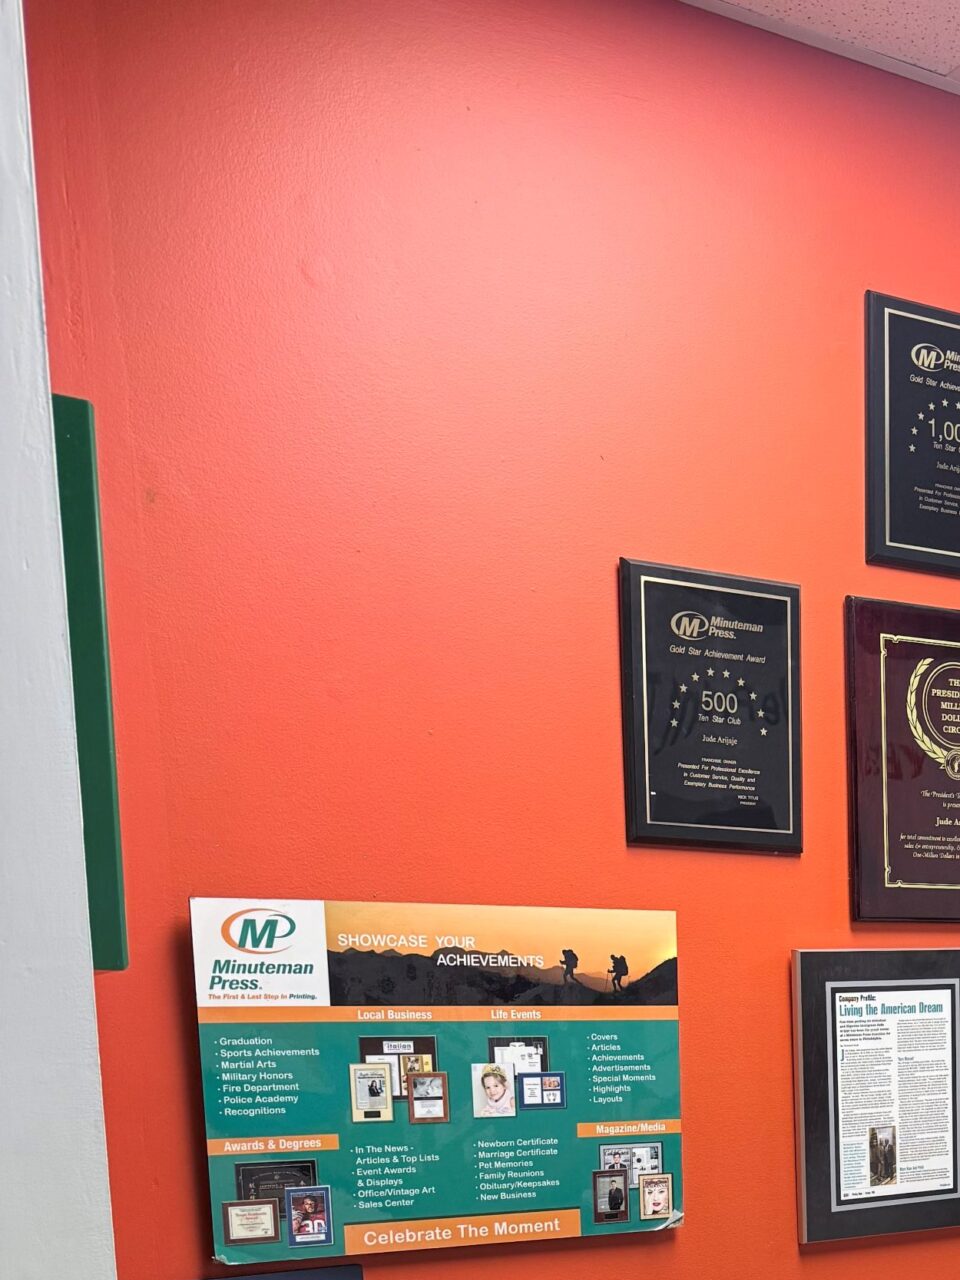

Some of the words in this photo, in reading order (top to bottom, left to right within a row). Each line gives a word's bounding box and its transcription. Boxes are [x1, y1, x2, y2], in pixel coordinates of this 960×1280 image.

[910, 374, 923, 384] Gold
[926, 377, 937, 387] Star
[933, 441, 942, 450] Ten
[945, 443, 956, 453] Star
[701, 691, 738, 714] 500
[935, 817, 952, 826] Jude
[337, 934, 428, 948] SHOWCASE
[436, 936, 475, 949] YOUR
[212, 959, 314, 975] Minuteman
[437, 954, 544, 968] ACHIEVEMENTS
[357, 1009, 384, 1020] Local
[388, 1010, 432, 1020] Business
[491, 1009, 508, 1019] Life
[511, 1009, 541, 1020] Events
[839, 1003, 863, 1018] Living
[866, 1003, 878, 1015] the
[881, 1002, 916, 1016] American
[919, 1002, 943, 1014] Dream
[219, 1037, 272, 1046] Graduation
[220, 1049, 252, 1058] Sports
[254, 1048, 320, 1057] Achievements
[222, 1072, 258, 1082] Military
[259, 1071, 293, 1081] Honors
[592, 1074, 621, 1083] Special
[622, 1073, 656, 1082] Moments
[224, 1107, 286, 1117] Recognitions
[596, 1123, 666, 1135] Magazine/Media
[224, 1141, 265, 1152] Awards
[267, 1140, 276, 1149] &
[279, 1138, 322, 1150] Degrees
[477, 1140, 515, 1148] Newborn
[516, 1138, 558, 1147] Certificate
[363, 1226, 452, 1246] Celebrate
[457, 1223, 488, 1239] The
[494, 1218, 560, 1236] Moment
